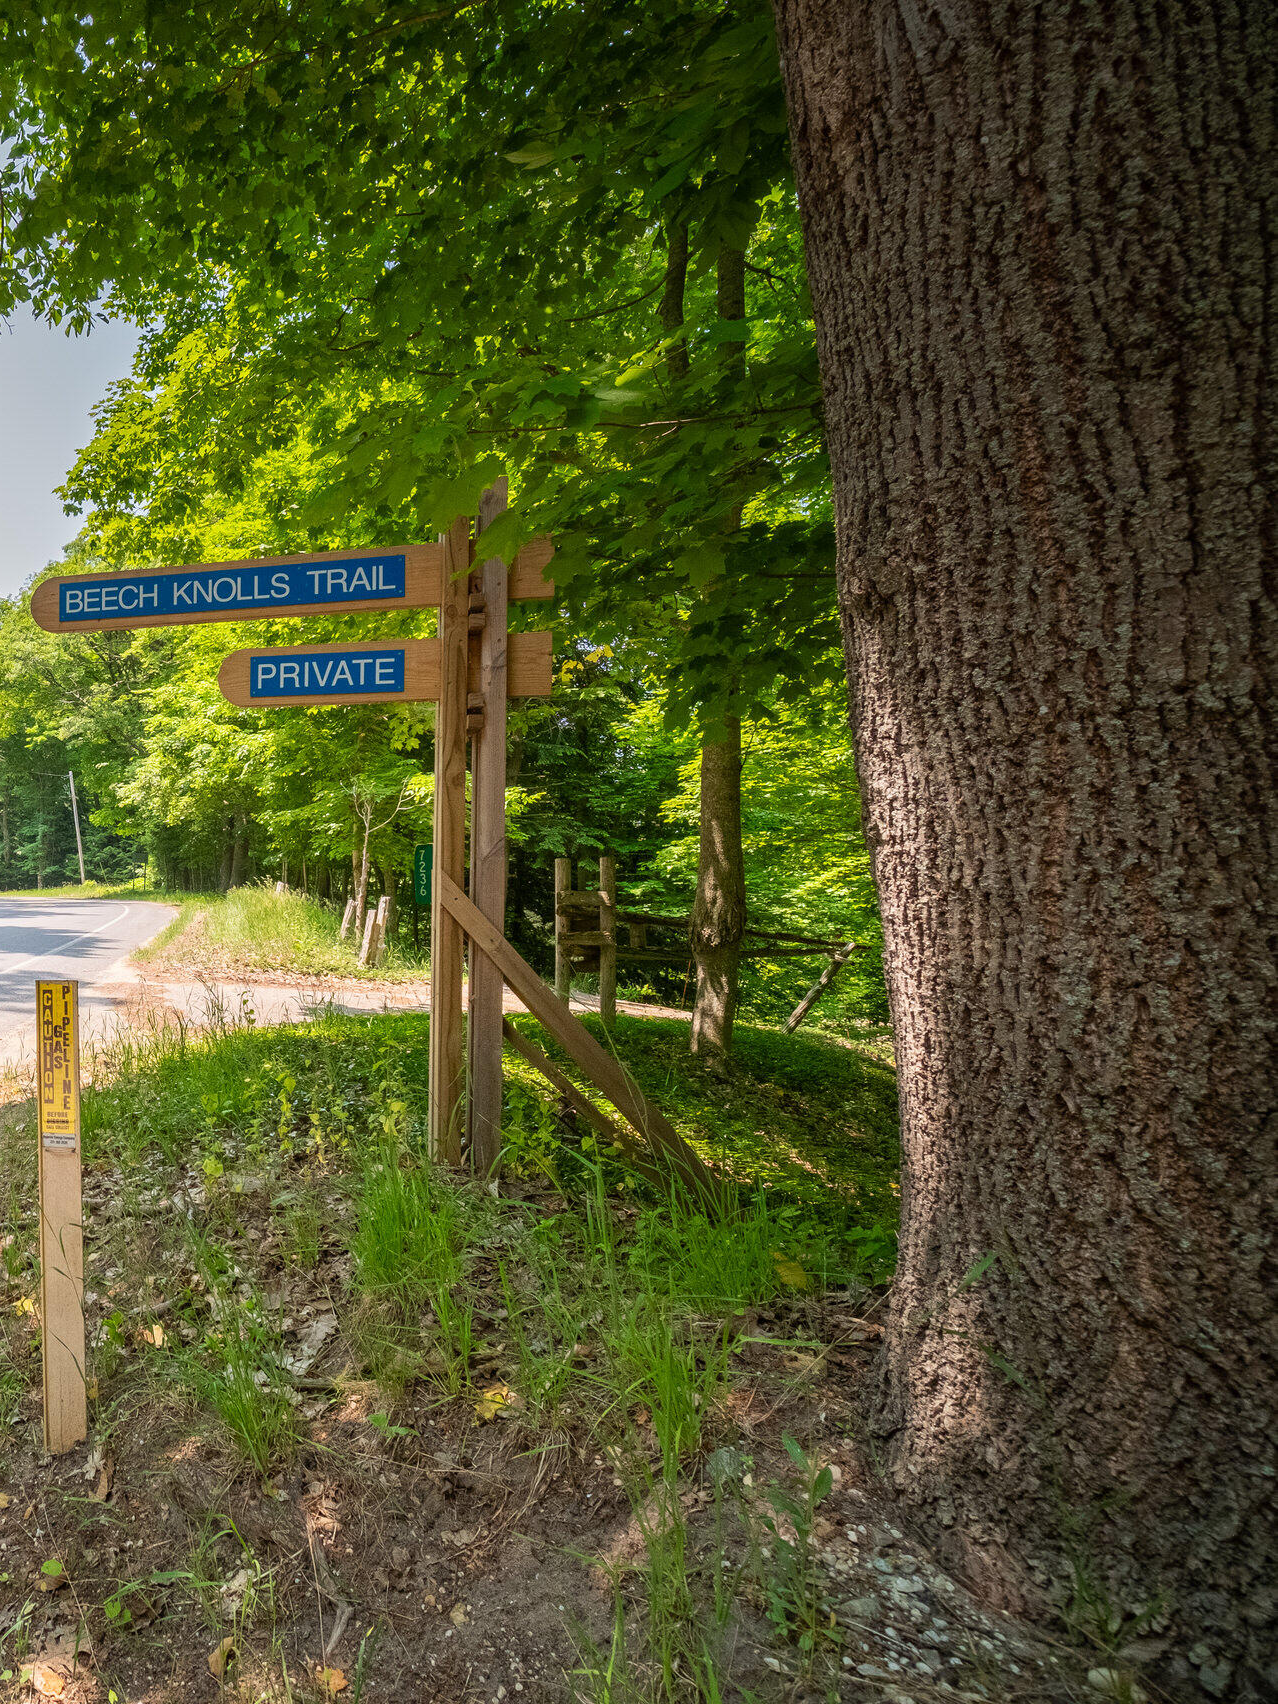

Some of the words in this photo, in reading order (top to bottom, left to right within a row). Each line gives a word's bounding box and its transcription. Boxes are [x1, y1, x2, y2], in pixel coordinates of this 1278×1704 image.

[65, 584, 158, 614] BEECH
[172, 572, 290, 605] KNOLLS
[306, 565, 396, 595] TRAIL
[257, 658, 396, 689] PRIVATE
[419, 849, 427, 896] 7236
[43, 992, 54, 1101] CAUTION
[53, 1024, 63, 1069] GAS
[62, 985, 72, 1110] PIPELINE
